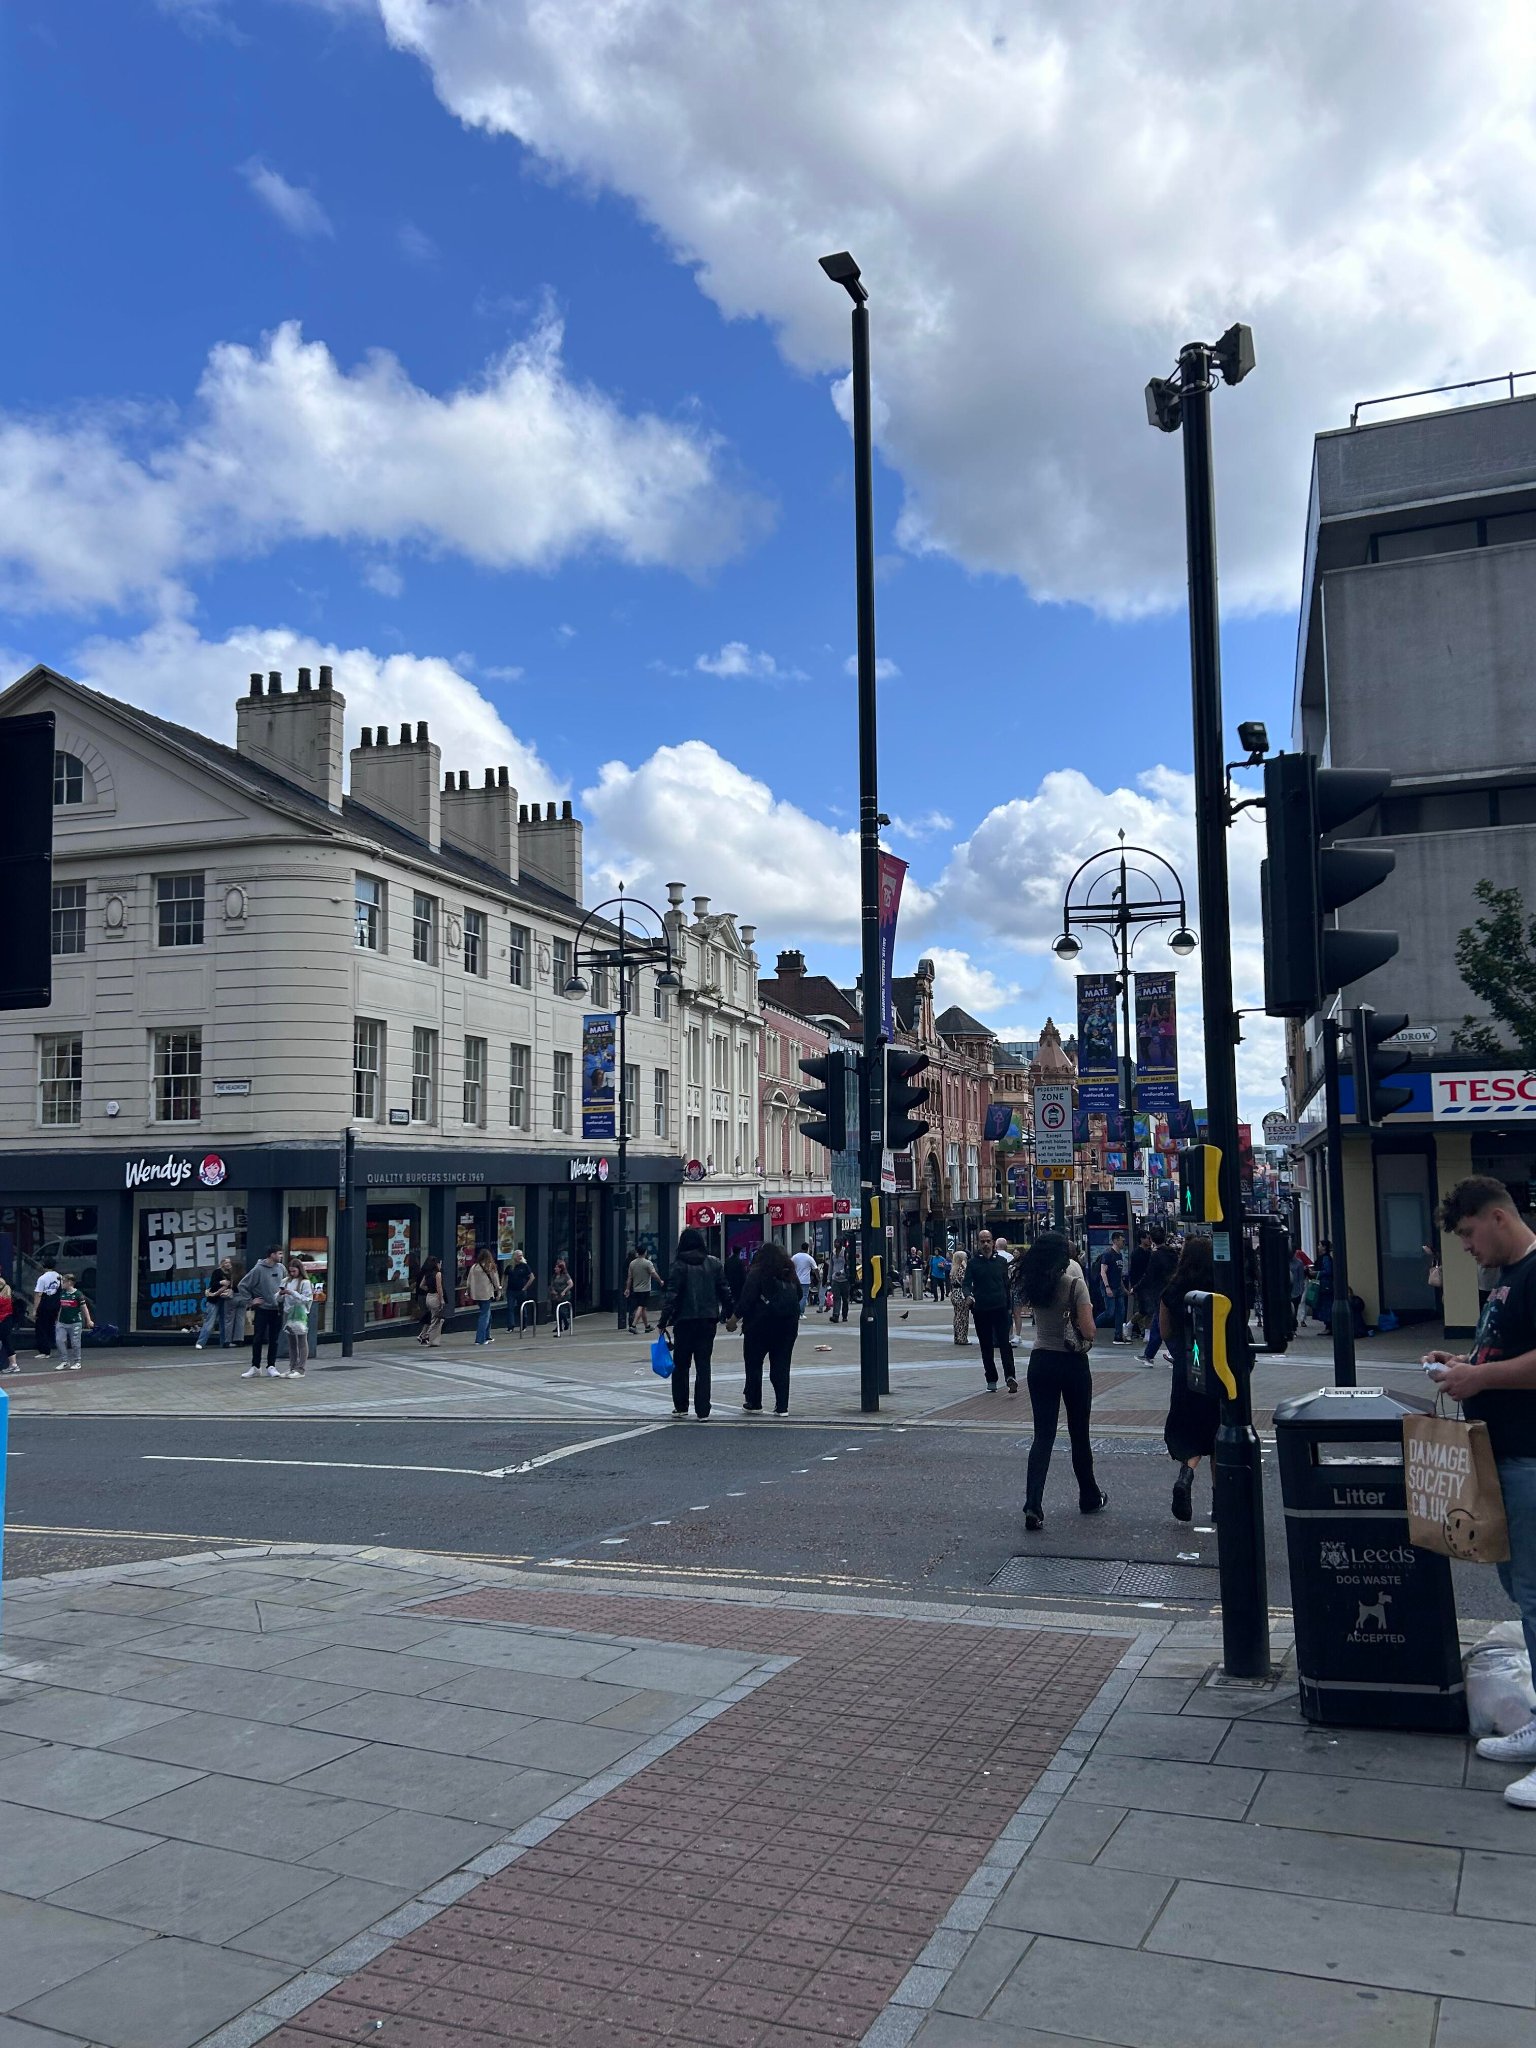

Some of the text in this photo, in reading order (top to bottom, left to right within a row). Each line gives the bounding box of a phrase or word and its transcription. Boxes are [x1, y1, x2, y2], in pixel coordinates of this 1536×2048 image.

[1085, 987, 1108, 997] MATE
[1143, 986, 1167, 996] MATE
[589, 1025, 609, 1034] MATE
[1042, 1093, 1064, 1101] ZONE
[1269, 1135, 1296, 1143] express
[125, 1154, 192, 1188] Wendy's
[570, 1156, 597, 1181] Wendy's
[367, 1173, 485, 1183] QUALITY BURGERS SINCE 1969
[147, 1205, 235, 1237] FRESH
[149, 1232, 237, 1272] BEEF
[150, 1279, 200, 1298] UNLIKE
[150, 1299, 198, 1318] OTHER
[1333, 1488, 1386, 1505] Litter
[1351, 1545, 1416, 1564] Leeds
[1336, 1575, 1402, 1585] DOG WASTE
[1346, 1633, 1406, 1643] ACCEPTED
